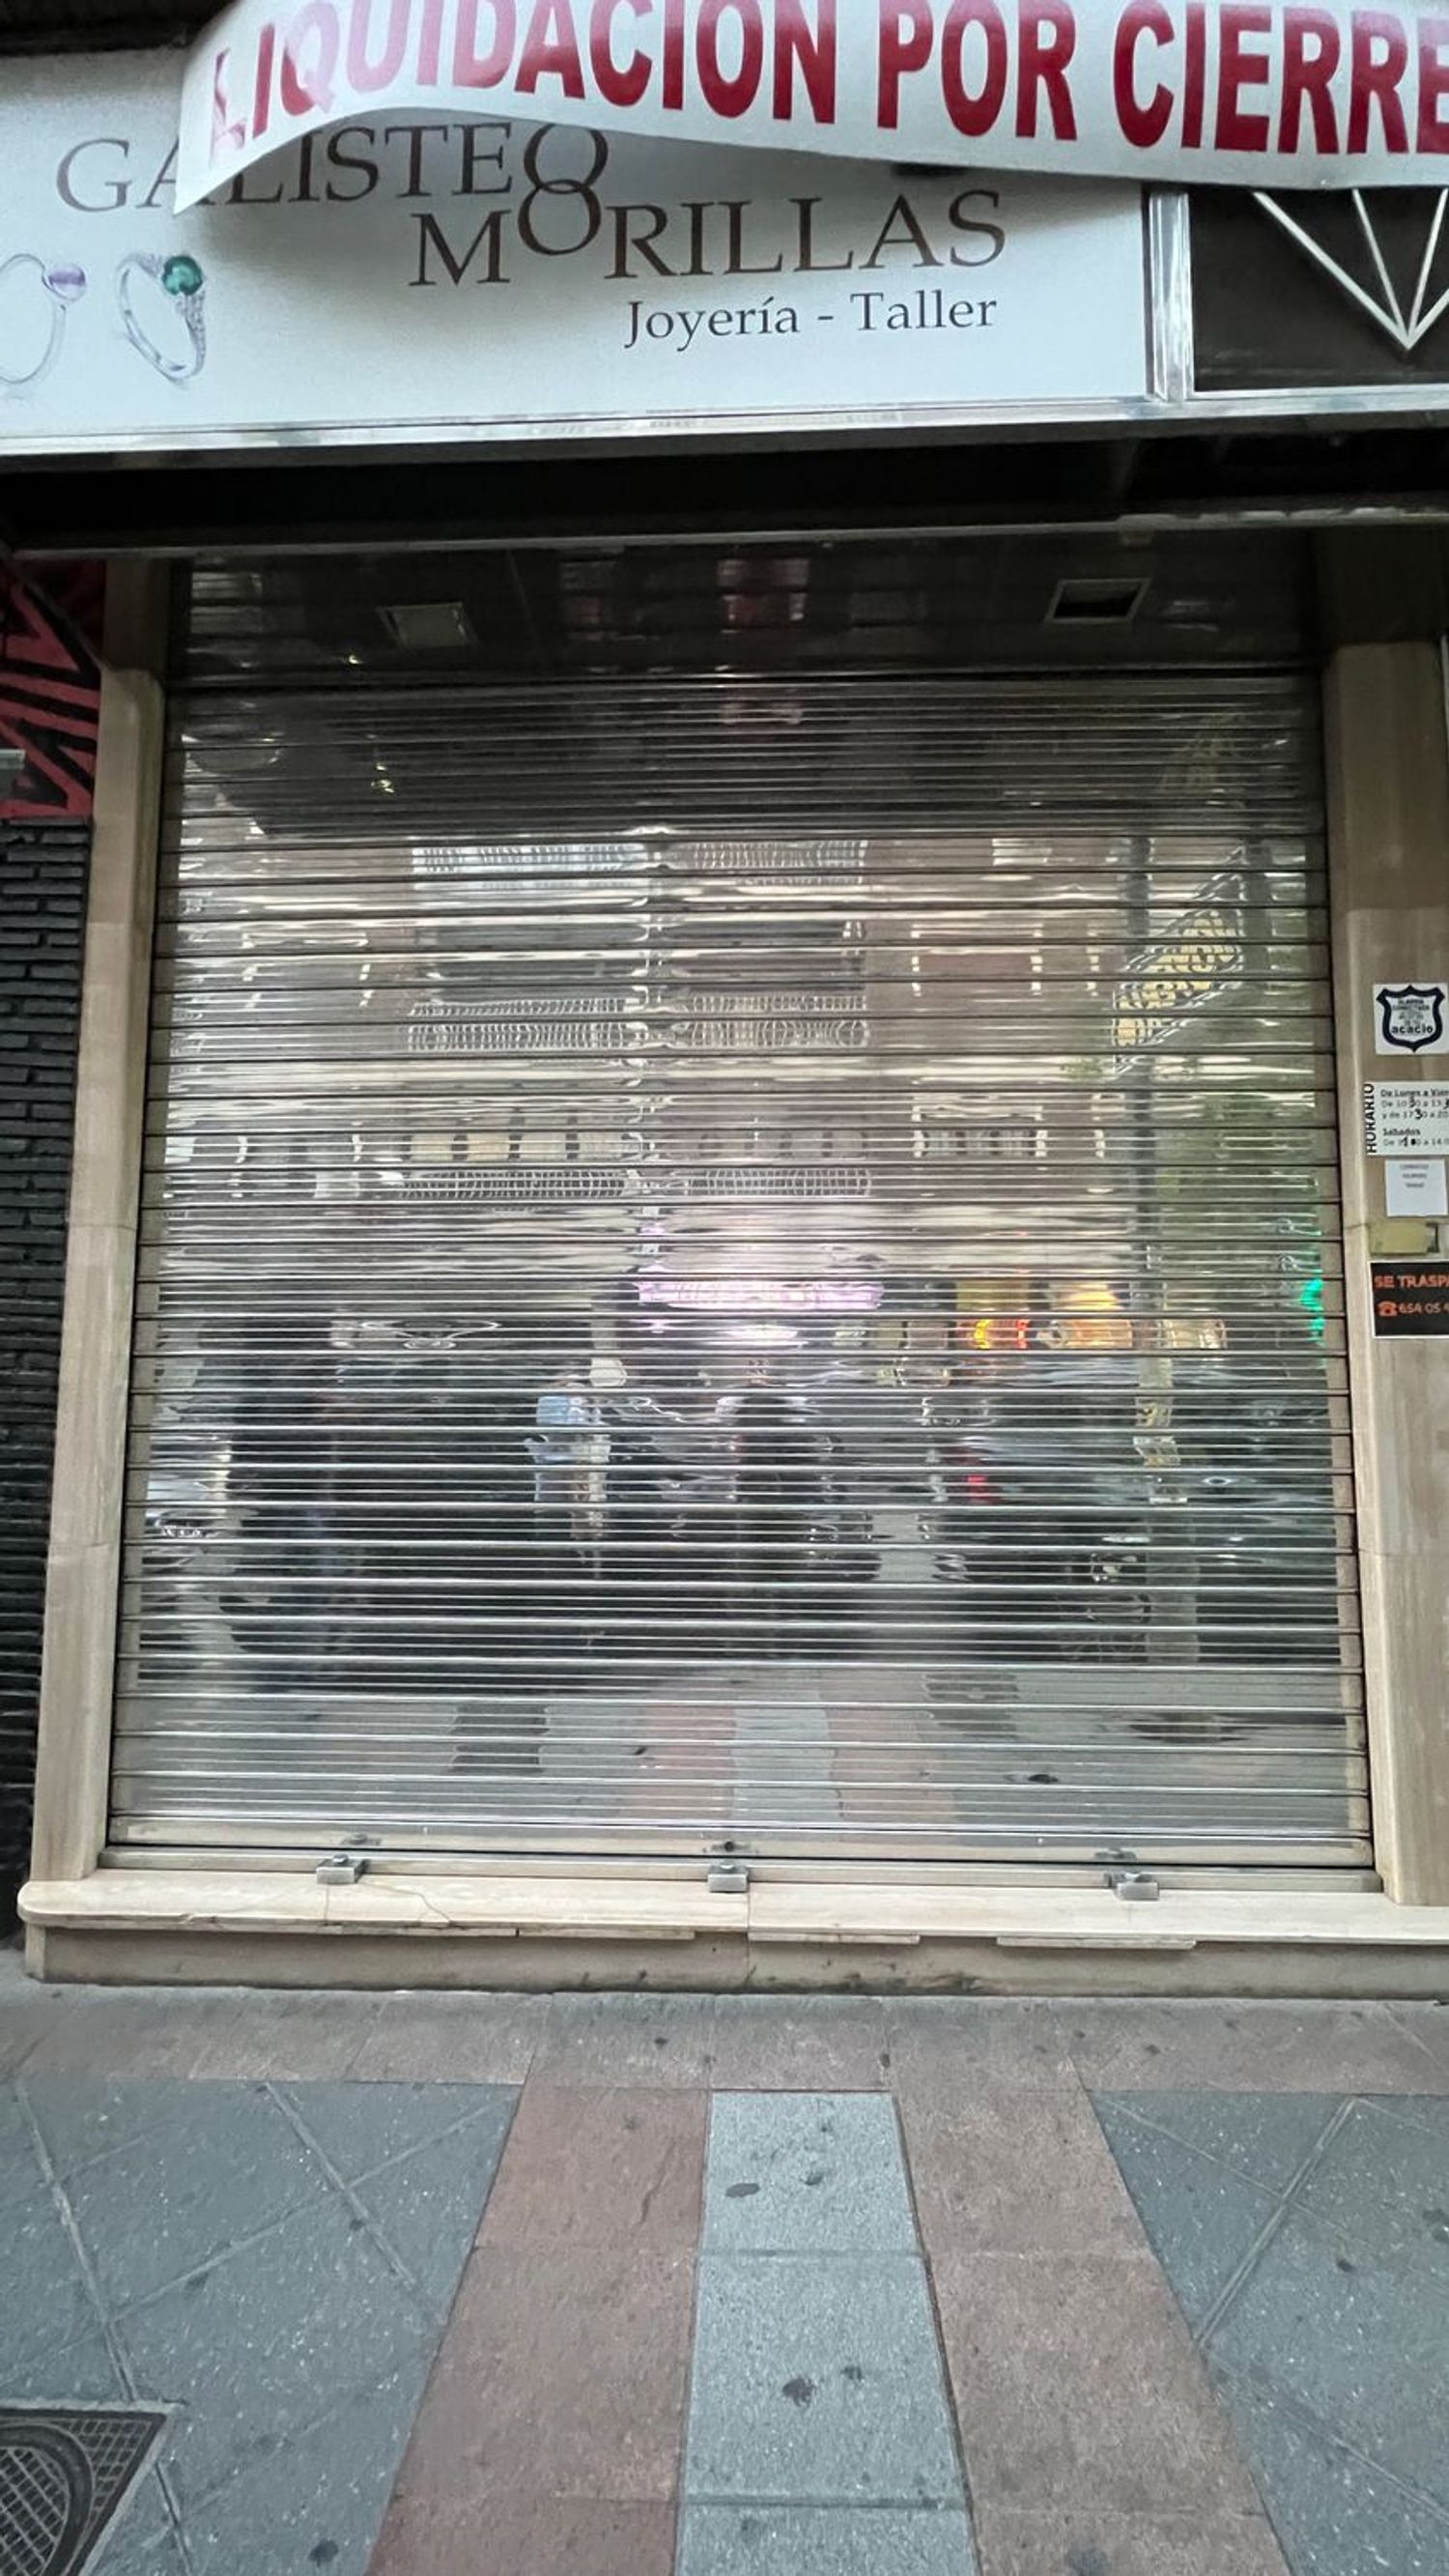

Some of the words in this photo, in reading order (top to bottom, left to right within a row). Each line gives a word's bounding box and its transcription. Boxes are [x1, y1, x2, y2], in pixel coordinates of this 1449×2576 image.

[877, 0, 1077, 141] POR
[1114, 0, 1449, 155] CIERRE
[408, 179, 1006, 287] MORILLAS
[624, 296, 800, 352] Joyería
[850, 289, 997, 330] Taller
[1362, 1083, 1377, 1154] HORARIO
[1375, 1275, 1395, 1288] SE
